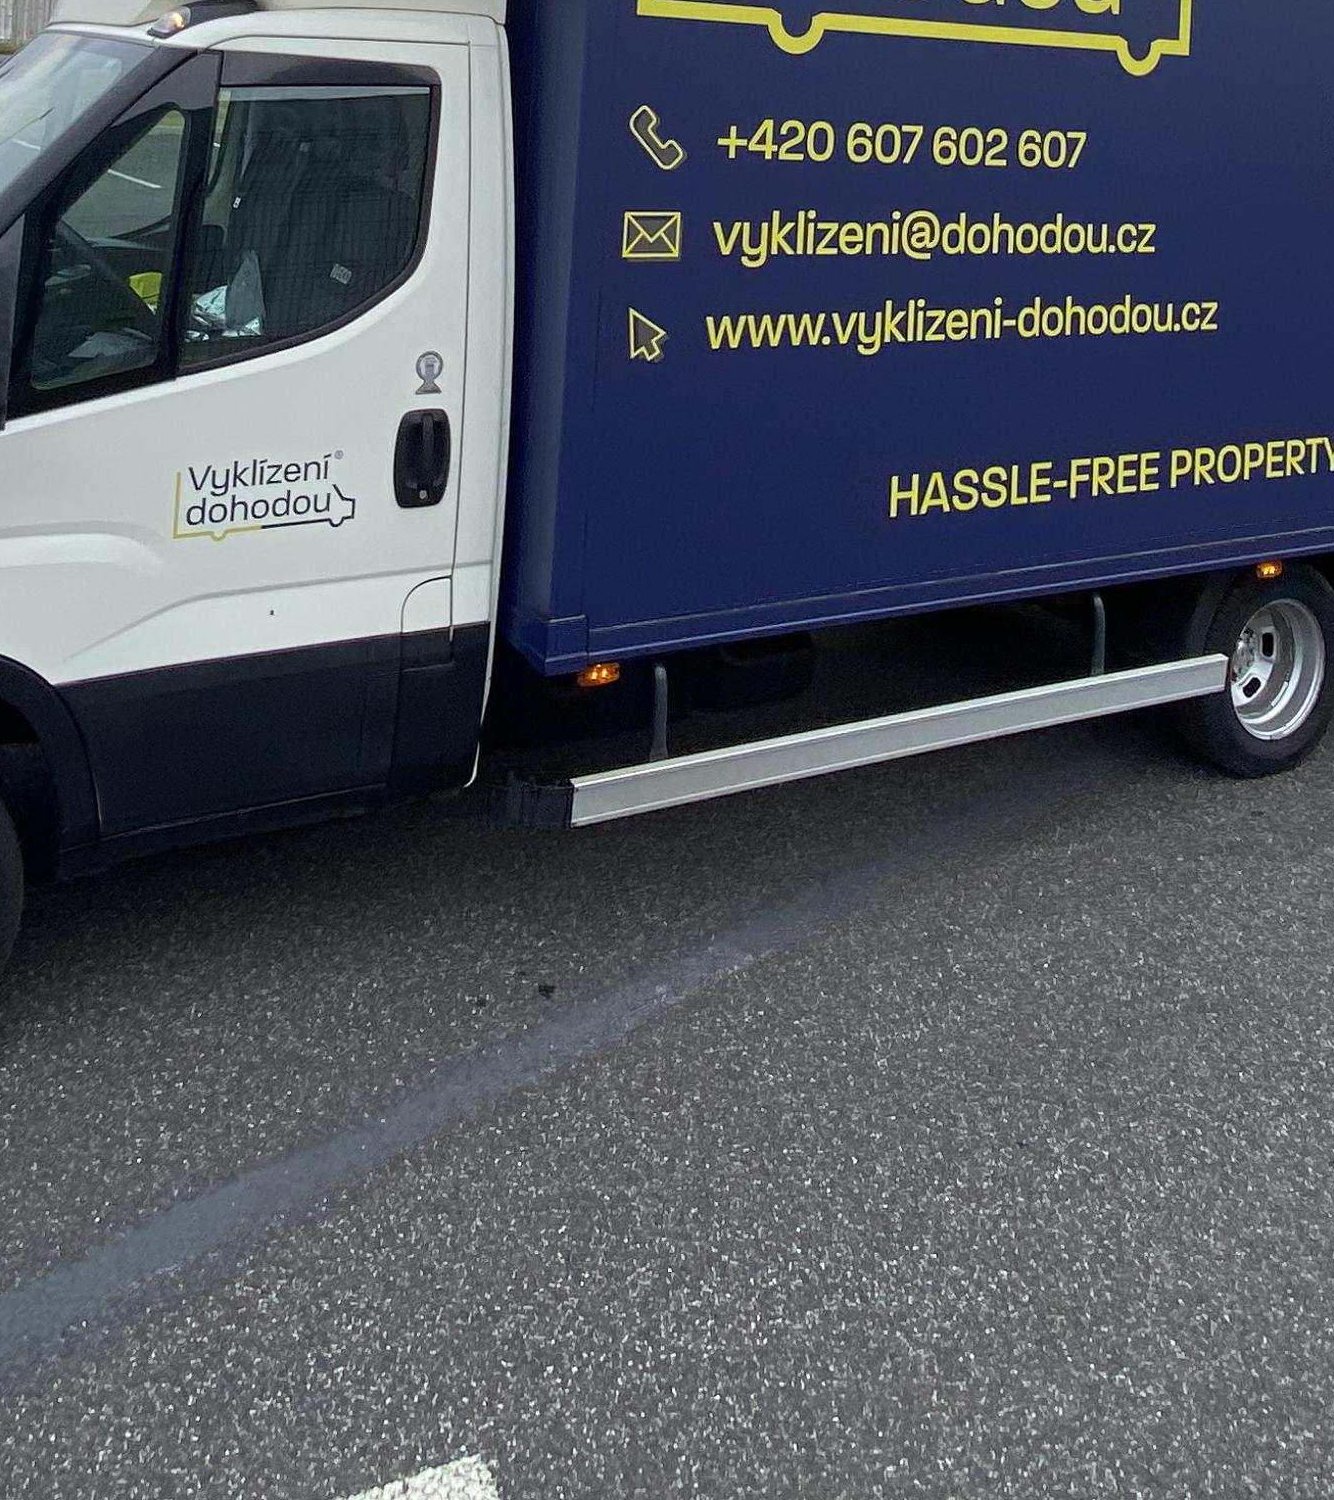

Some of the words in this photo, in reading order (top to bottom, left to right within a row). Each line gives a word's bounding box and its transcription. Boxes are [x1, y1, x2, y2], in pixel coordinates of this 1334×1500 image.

[717, 119, 835, 162] +420
[846, 121, 924, 165] 607
[933, 125, 1008, 167] 602
[1018, 129, 1087, 169] 607
[713, 209, 1156, 269] vyklizeni@dohodou.cz
[705, 294, 1218, 357] www.vyklizeni-dohodou.cz
[186, 490, 331, 525] dohodou
[889, 451, 1160, 517] HASSLE-FREE
